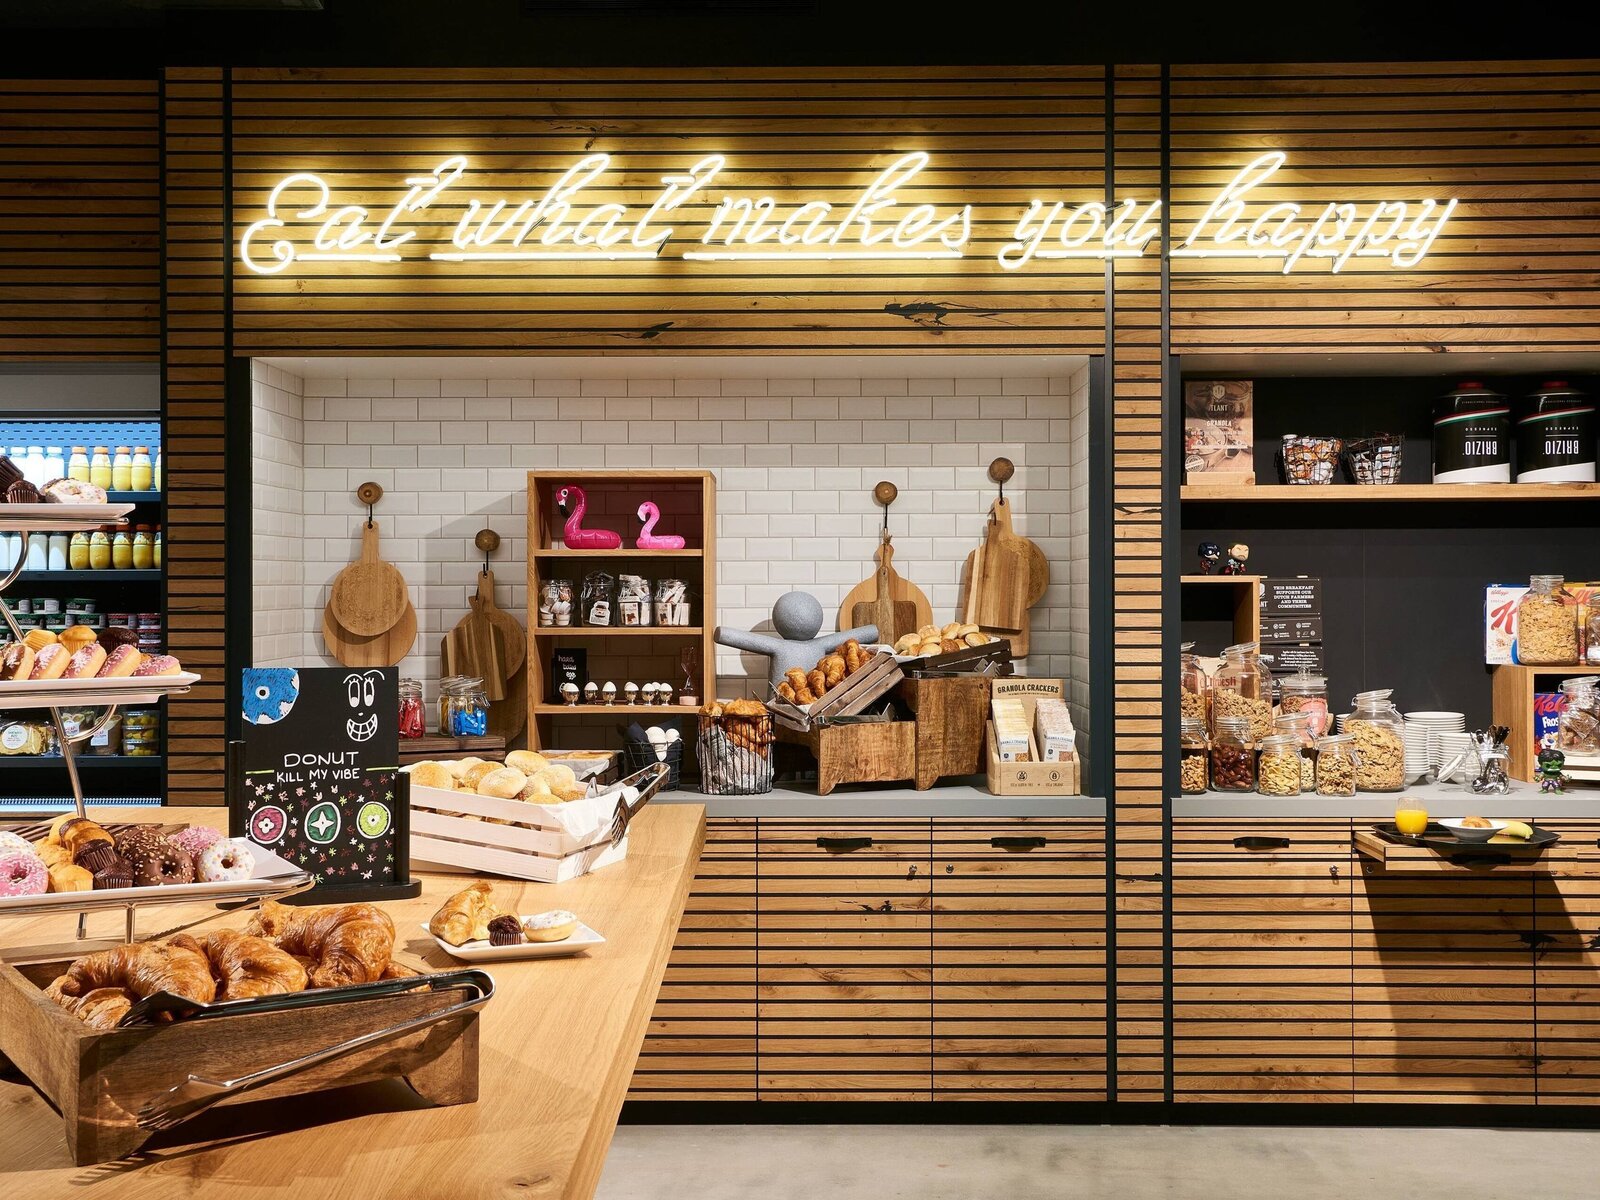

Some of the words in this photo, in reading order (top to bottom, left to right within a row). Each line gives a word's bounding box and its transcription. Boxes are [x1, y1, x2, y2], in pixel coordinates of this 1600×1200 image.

[241, 155, 468, 274] Eat
[451, 153, 726, 251] what
[702, 151, 973, 250] makes
[998, 198, 1163, 270] you
[1185, 150, 1459, 274] happy
[1465, 441, 1498, 455] BRIZIO
[1545, 440, 1579, 455] BRIZIO
[1490, 600, 1519, 635] K
[997, 684, 1026, 694] GRANOLA
[1026, 684, 1060, 694] CRACKERS
[284, 751, 359, 768] DONUT
[276, 771, 304, 783] KILL
[308, 768, 328, 780] MY
[332, 768, 360, 780] VIBE
